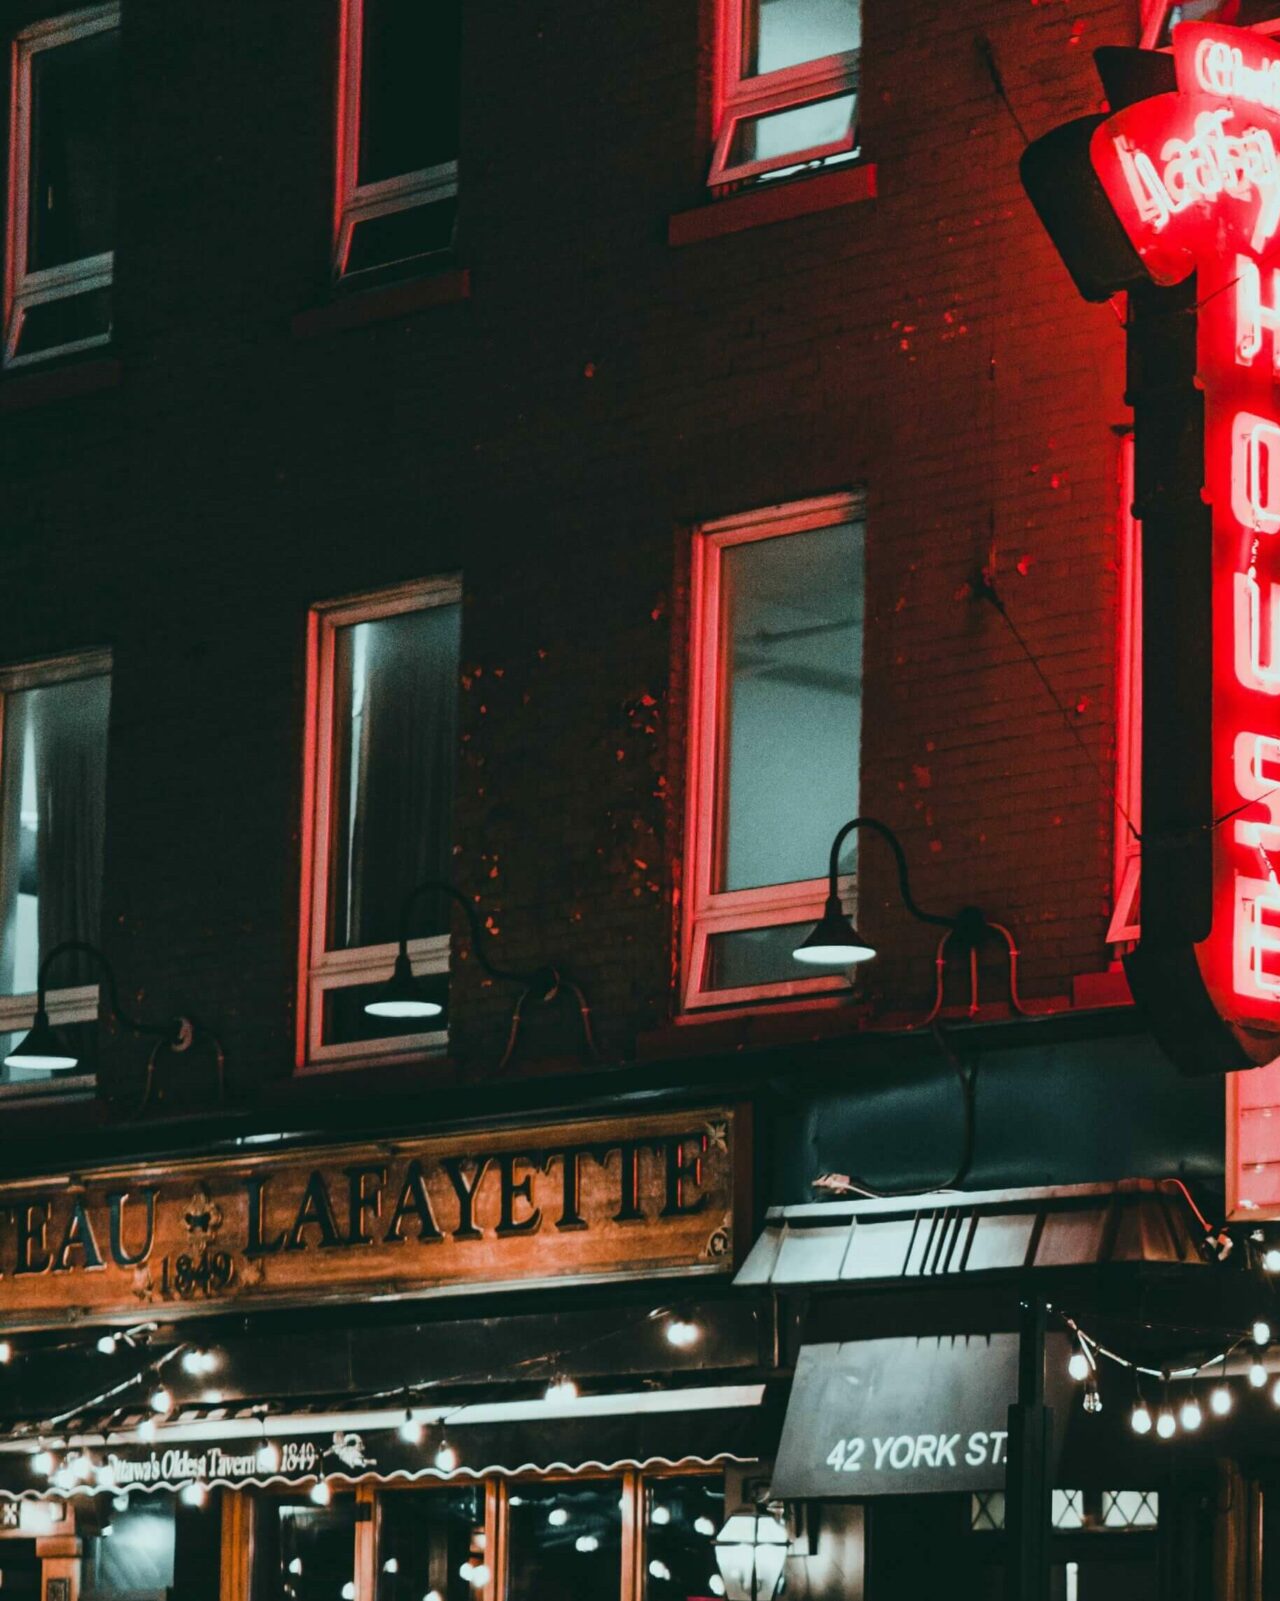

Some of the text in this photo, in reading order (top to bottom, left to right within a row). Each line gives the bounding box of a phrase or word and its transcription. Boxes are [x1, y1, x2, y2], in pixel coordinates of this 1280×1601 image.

[243, 1133, 708, 1258] LAFAYETTE
[160, 1251, 234, 1298] 1849
[281, 1442, 316, 1472] 1849
[826, 1431, 1008, 1472] 42 YORK ST.
